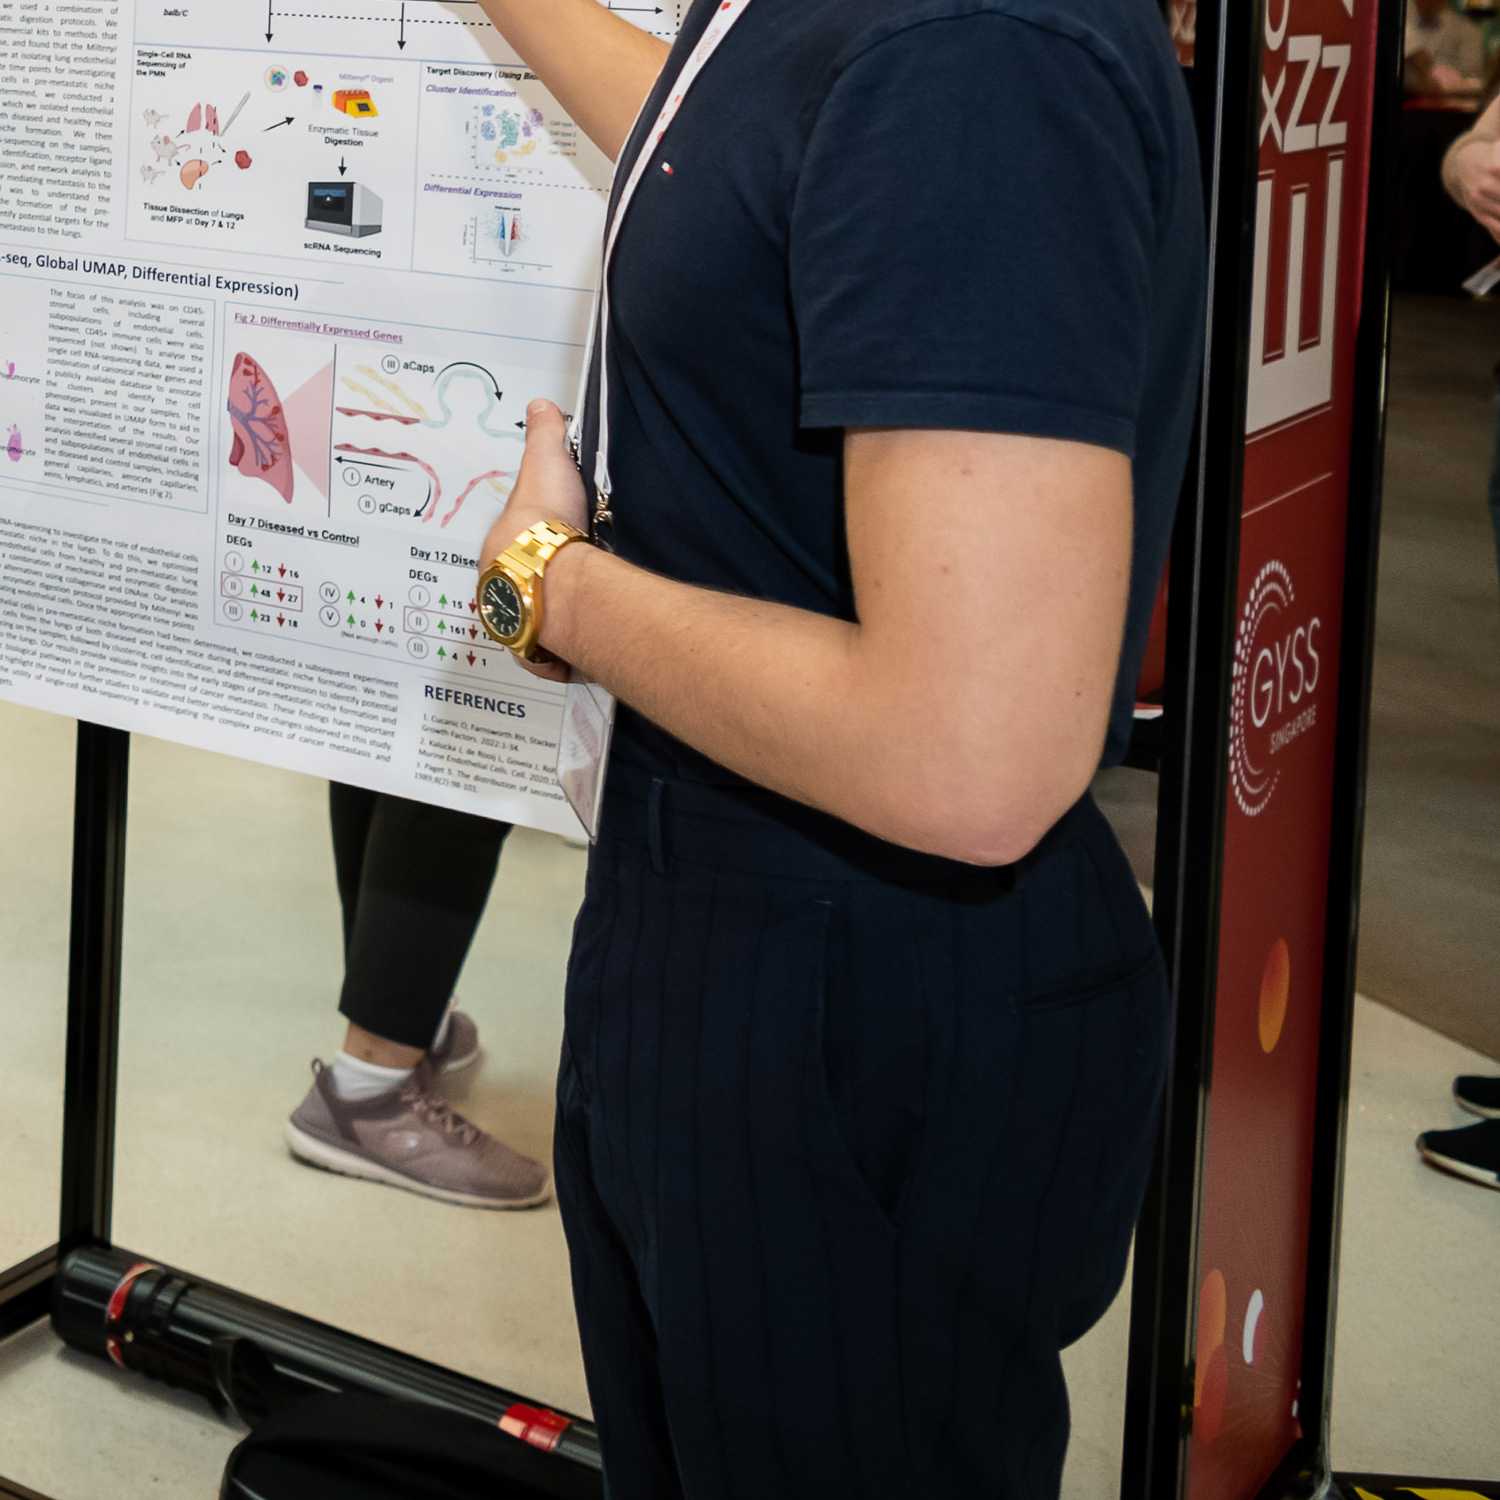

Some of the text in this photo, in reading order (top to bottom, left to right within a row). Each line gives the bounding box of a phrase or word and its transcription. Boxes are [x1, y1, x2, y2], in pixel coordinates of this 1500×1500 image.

[304, 242, 381, 258] scRNA Sequencing
[35, 254, 79, 272] Global
[132, 265, 211, 288] Differential
[215, 275, 299, 302] Expression)
[234, 312, 249, 324] Fig
[260, 317, 321, 335] Differentially
[324, 323, 370, 340] Expressed
[373, 331, 403, 343] Genes
[403, 361, 435, 375] aCaps
[365, 474, 395, 489] Artery
[379, 502, 410, 516] gCaps
[226, 535, 253, 547] DEGs
[228, 514, 359, 545] Day 7 Diseased vs Control
[409, 569, 438, 583] DEGs
[1251, 617, 1320, 727] GYSS
[424, 684, 526, 718] REFERENCES
[1270, 704, 1317, 754] SINGAPORE
